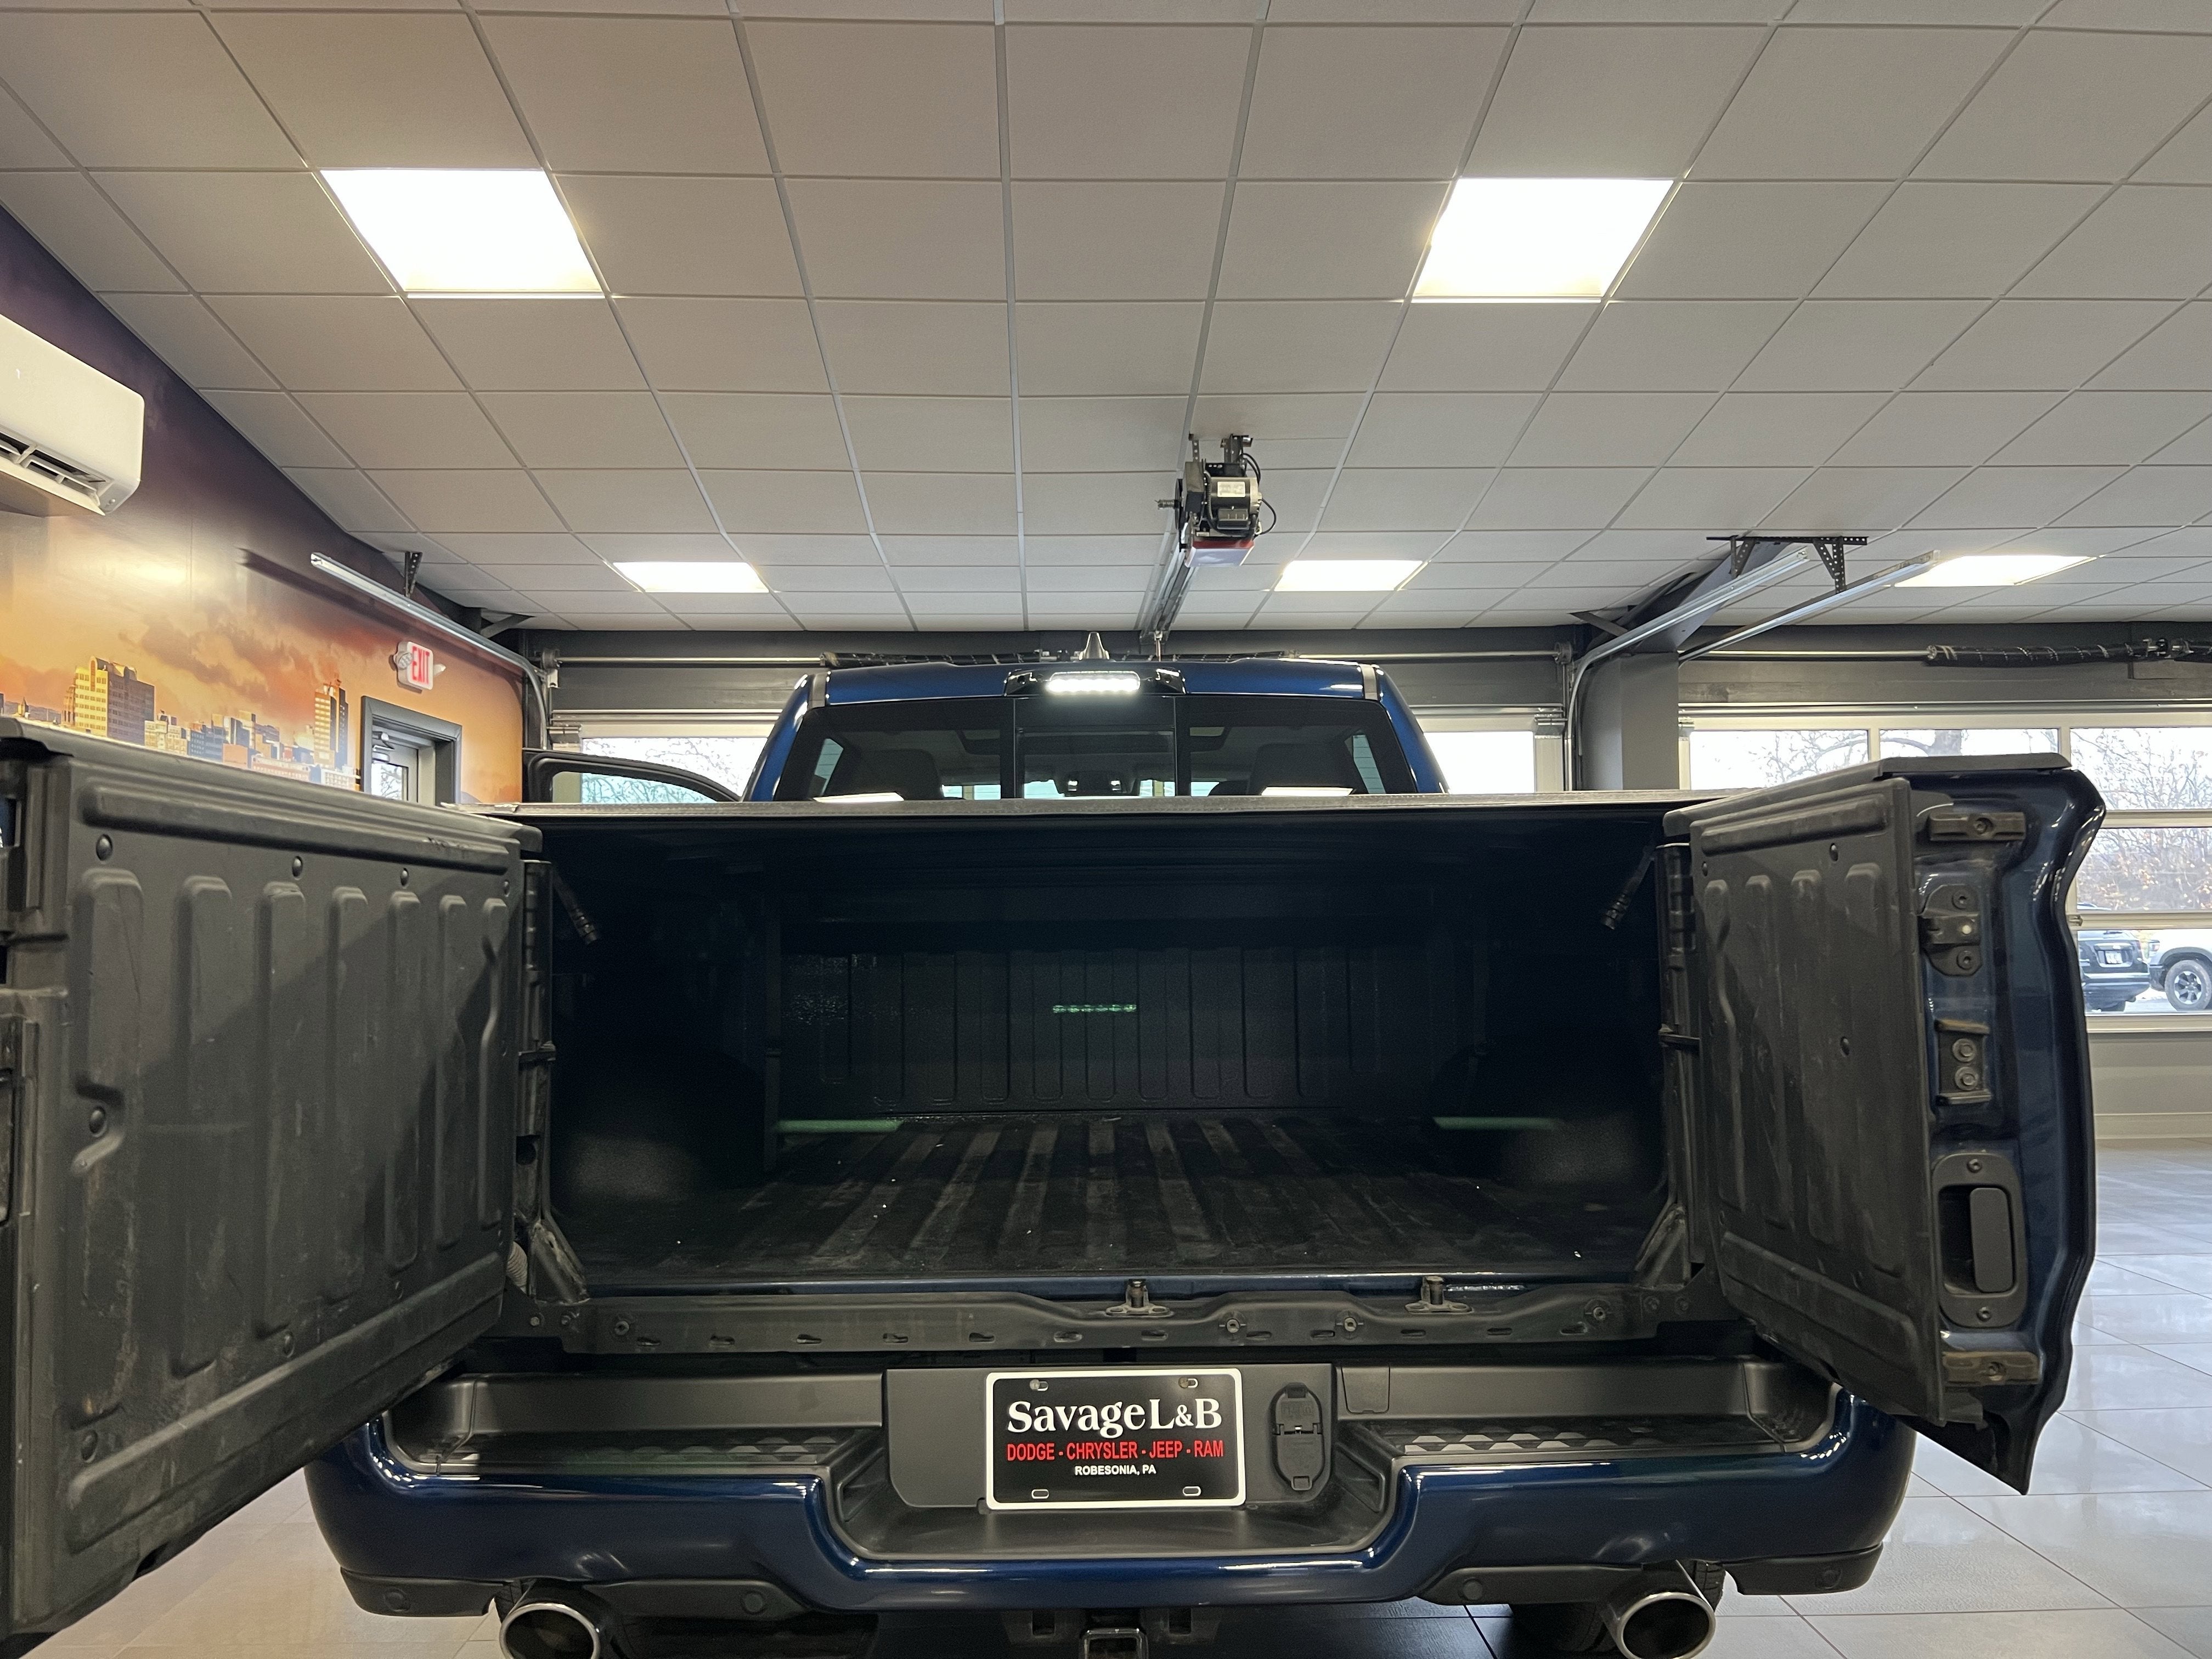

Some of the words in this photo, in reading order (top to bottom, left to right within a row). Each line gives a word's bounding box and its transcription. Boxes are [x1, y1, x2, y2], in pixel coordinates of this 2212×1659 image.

[412, 646, 430, 685] EXIT
[1007, 1443, 1055, 1462] DODGE
[1066, 1441, 1138, 1460] CHRYSLER
[1149, 1440, 1183, 1458] JEEP
[1194, 1439, 1224, 1458] RAM
[1074, 1464, 1140, 1476] ROBESONIA,
[1142, 1464, 1156, 1474] PA
